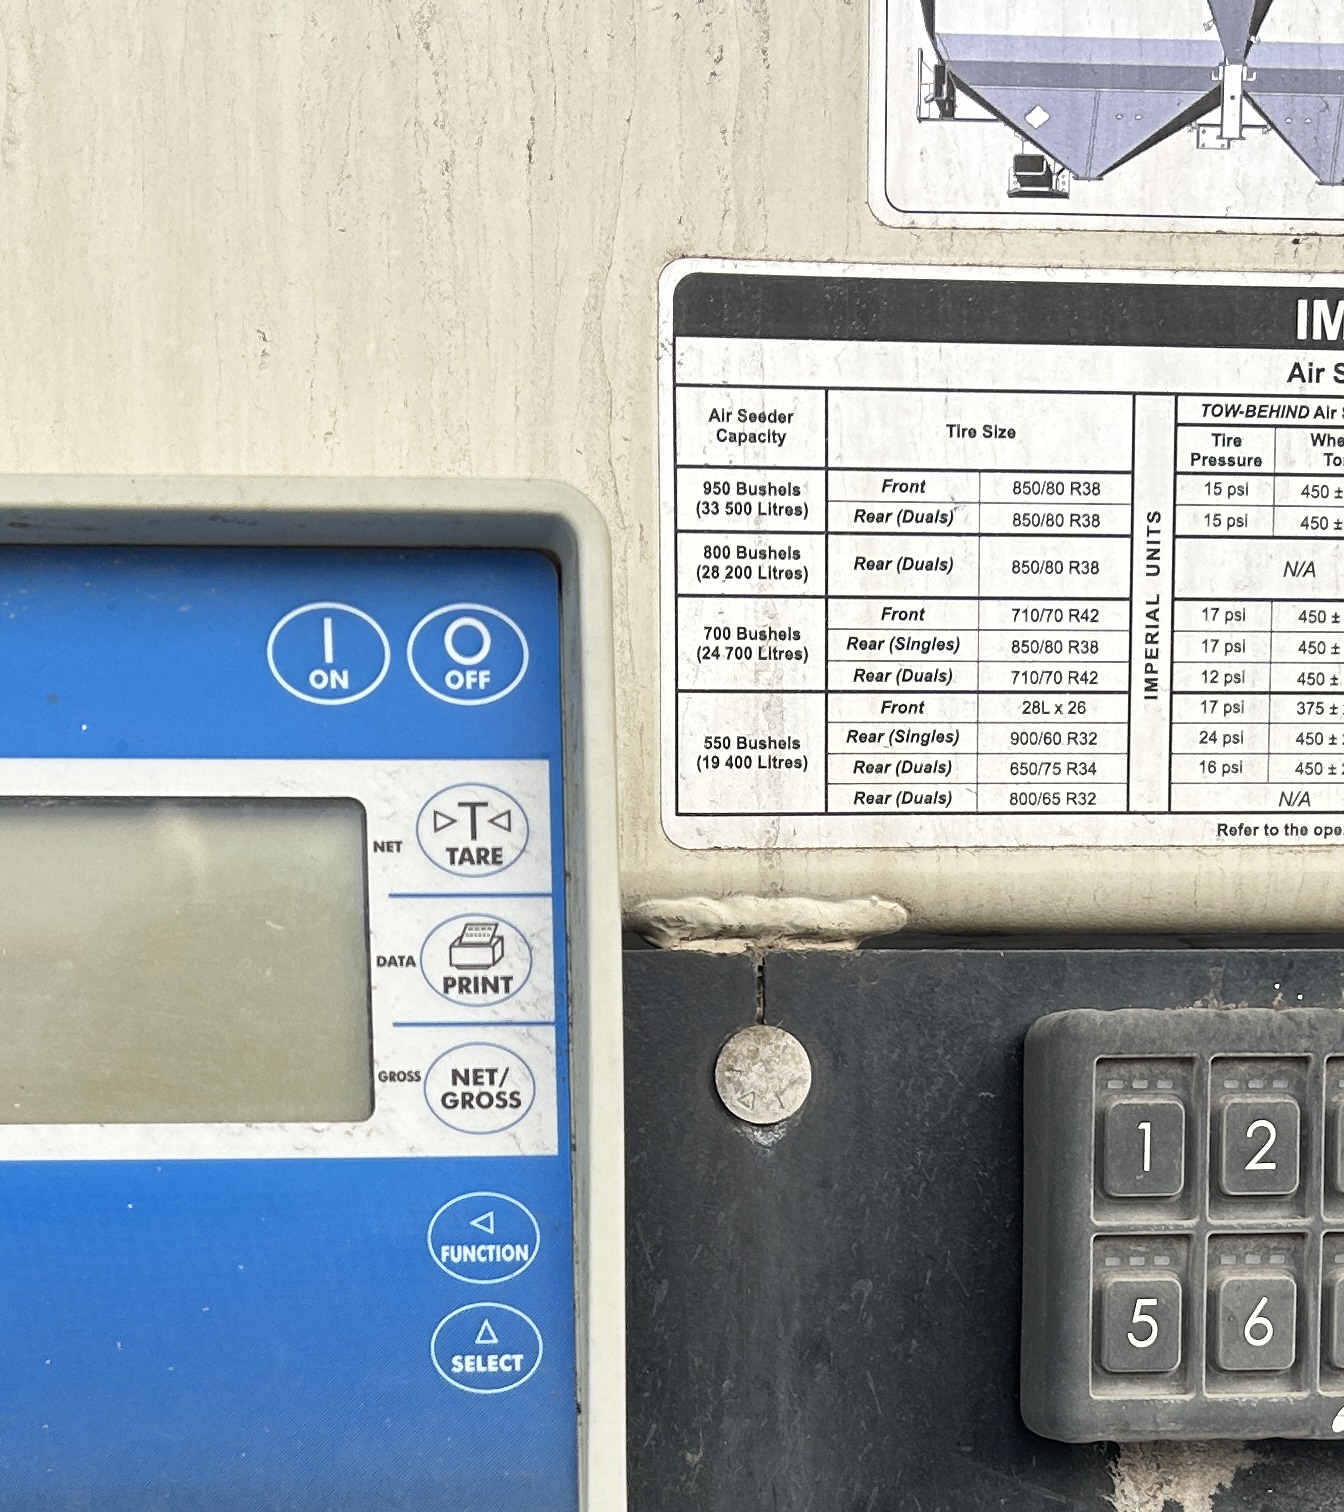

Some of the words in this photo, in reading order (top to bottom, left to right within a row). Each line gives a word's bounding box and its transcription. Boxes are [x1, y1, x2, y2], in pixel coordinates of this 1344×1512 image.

[1286, 362, 1326, 385] Air
[708, 406, 733, 423] Air
[737, 404, 794, 424] Seeder
[1201, 403, 1310, 419] TOW-BEHIND
[1313, 405, 1337, 420] Air
[715, 428, 787, 448] Capacity
[945, 423, 977, 439] Tire
[982, 424, 1017, 440] Size
[881, 478, 926, 494] Front
[1012, 480, 1065, 496] 850/80
[1070, 481, 1101, 496] R38
[1145, 509, 1162, 578] UNITS
[1143, 592, 1160, 701] IMPERIAL
[309, 669, 349, 690] ON
[444, 669, 491, 690] OFF
[1216, 822, 1259, 837] Refer
[1263, 823, 1279, 837] to
[1284, 823, 1308, 836] the
[373, 840, 403, 853] NET
[445, 847, 504, 866] TARE
[376, 955, 416, 968] DATA
[442, 975, 514, 995] PRINT
[378, 1070, 421, 1083] GROSS
[451, 1066, 509, 1088] NET/
[441, 1091, 522, 1111] GROSS
[1137, 1121, 1152, 1171] 1
[1244, 1119, 1277, 1171] 2
[441, 1244, 529, 1263] FUNCTION
[1127, 1298, 1159, 1348] 5
[1243, 1296, 1274, 1346] 6
[450, 1354, 524, 1373] SELECT
